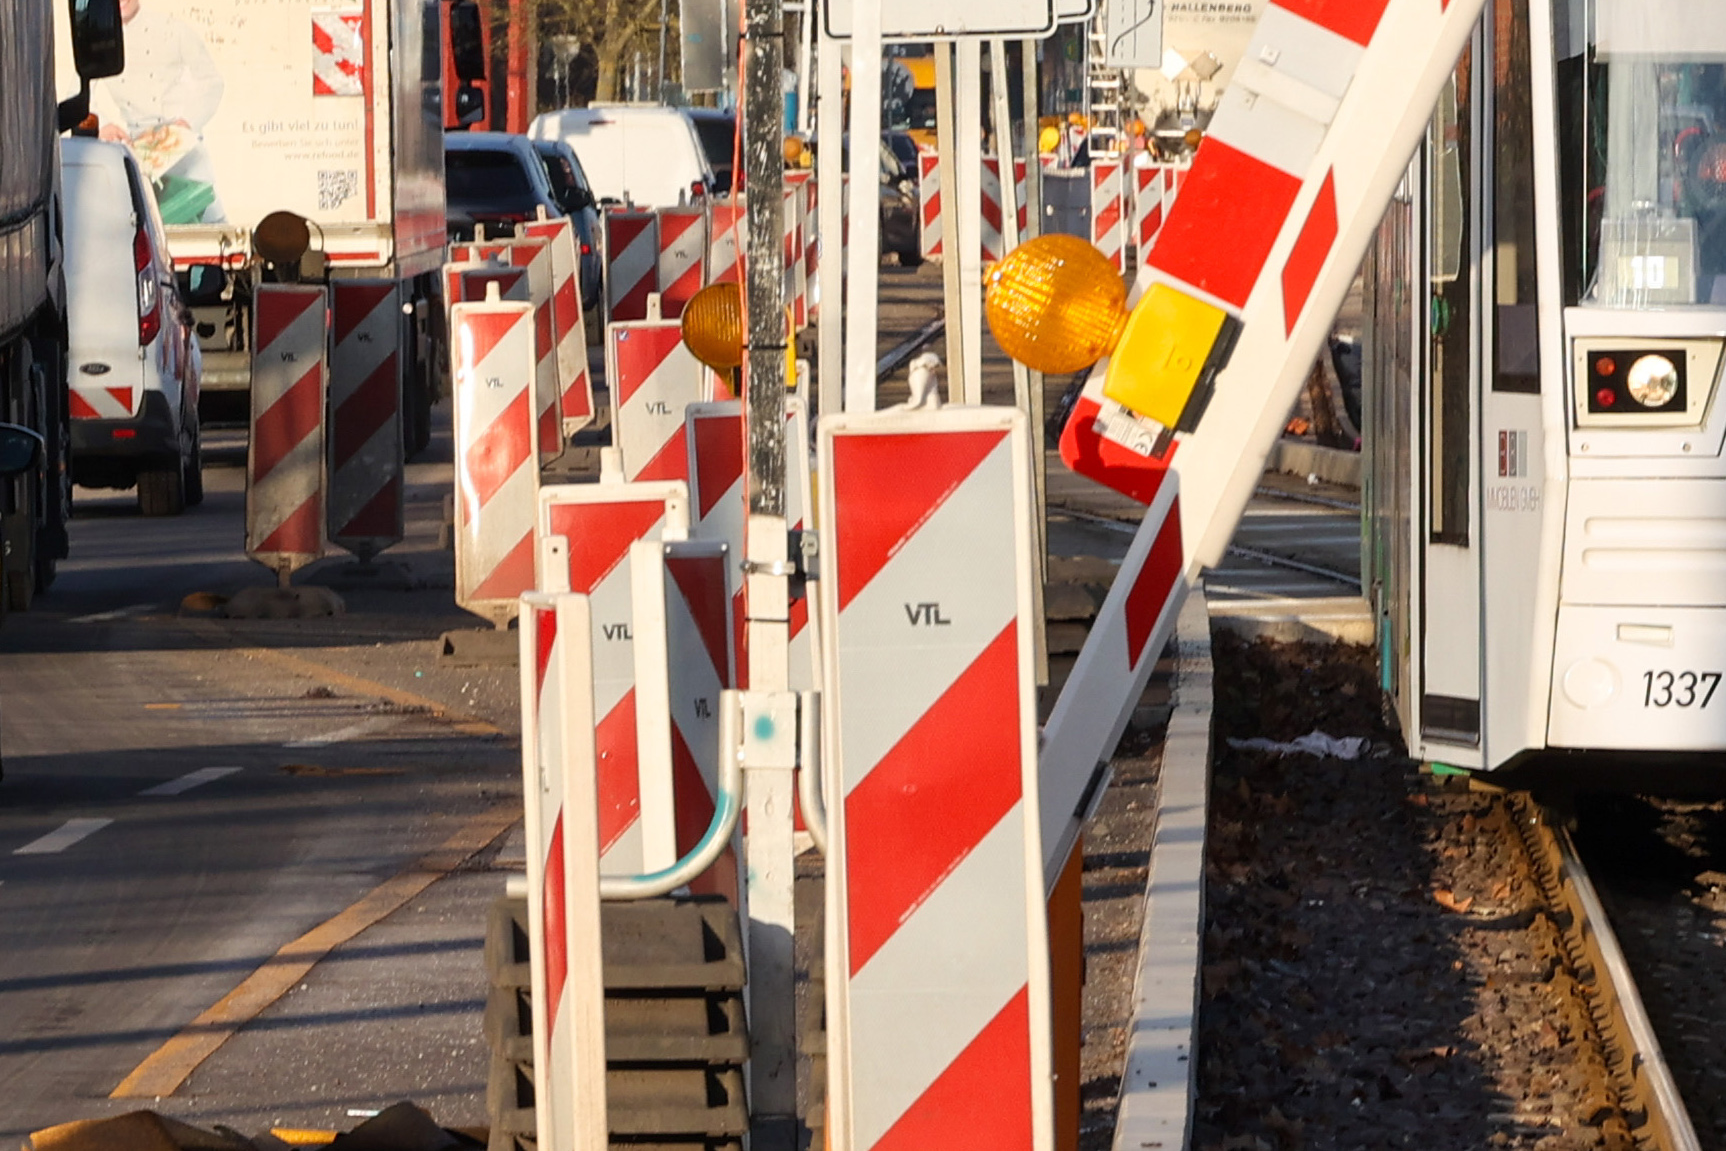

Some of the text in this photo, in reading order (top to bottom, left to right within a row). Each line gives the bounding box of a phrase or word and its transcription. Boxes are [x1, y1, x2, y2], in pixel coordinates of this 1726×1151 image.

[1631, 255, 1665, 289] 10
[485, 377, 504, 388] VTL
[645, 402, 672, 415] VTL
[904, 602, 952, 626] VTL
[602, 624, 633, 641] VTL
[1642, 670, 1723, 710] 1337
[693, 698, 712, 719] VTL
